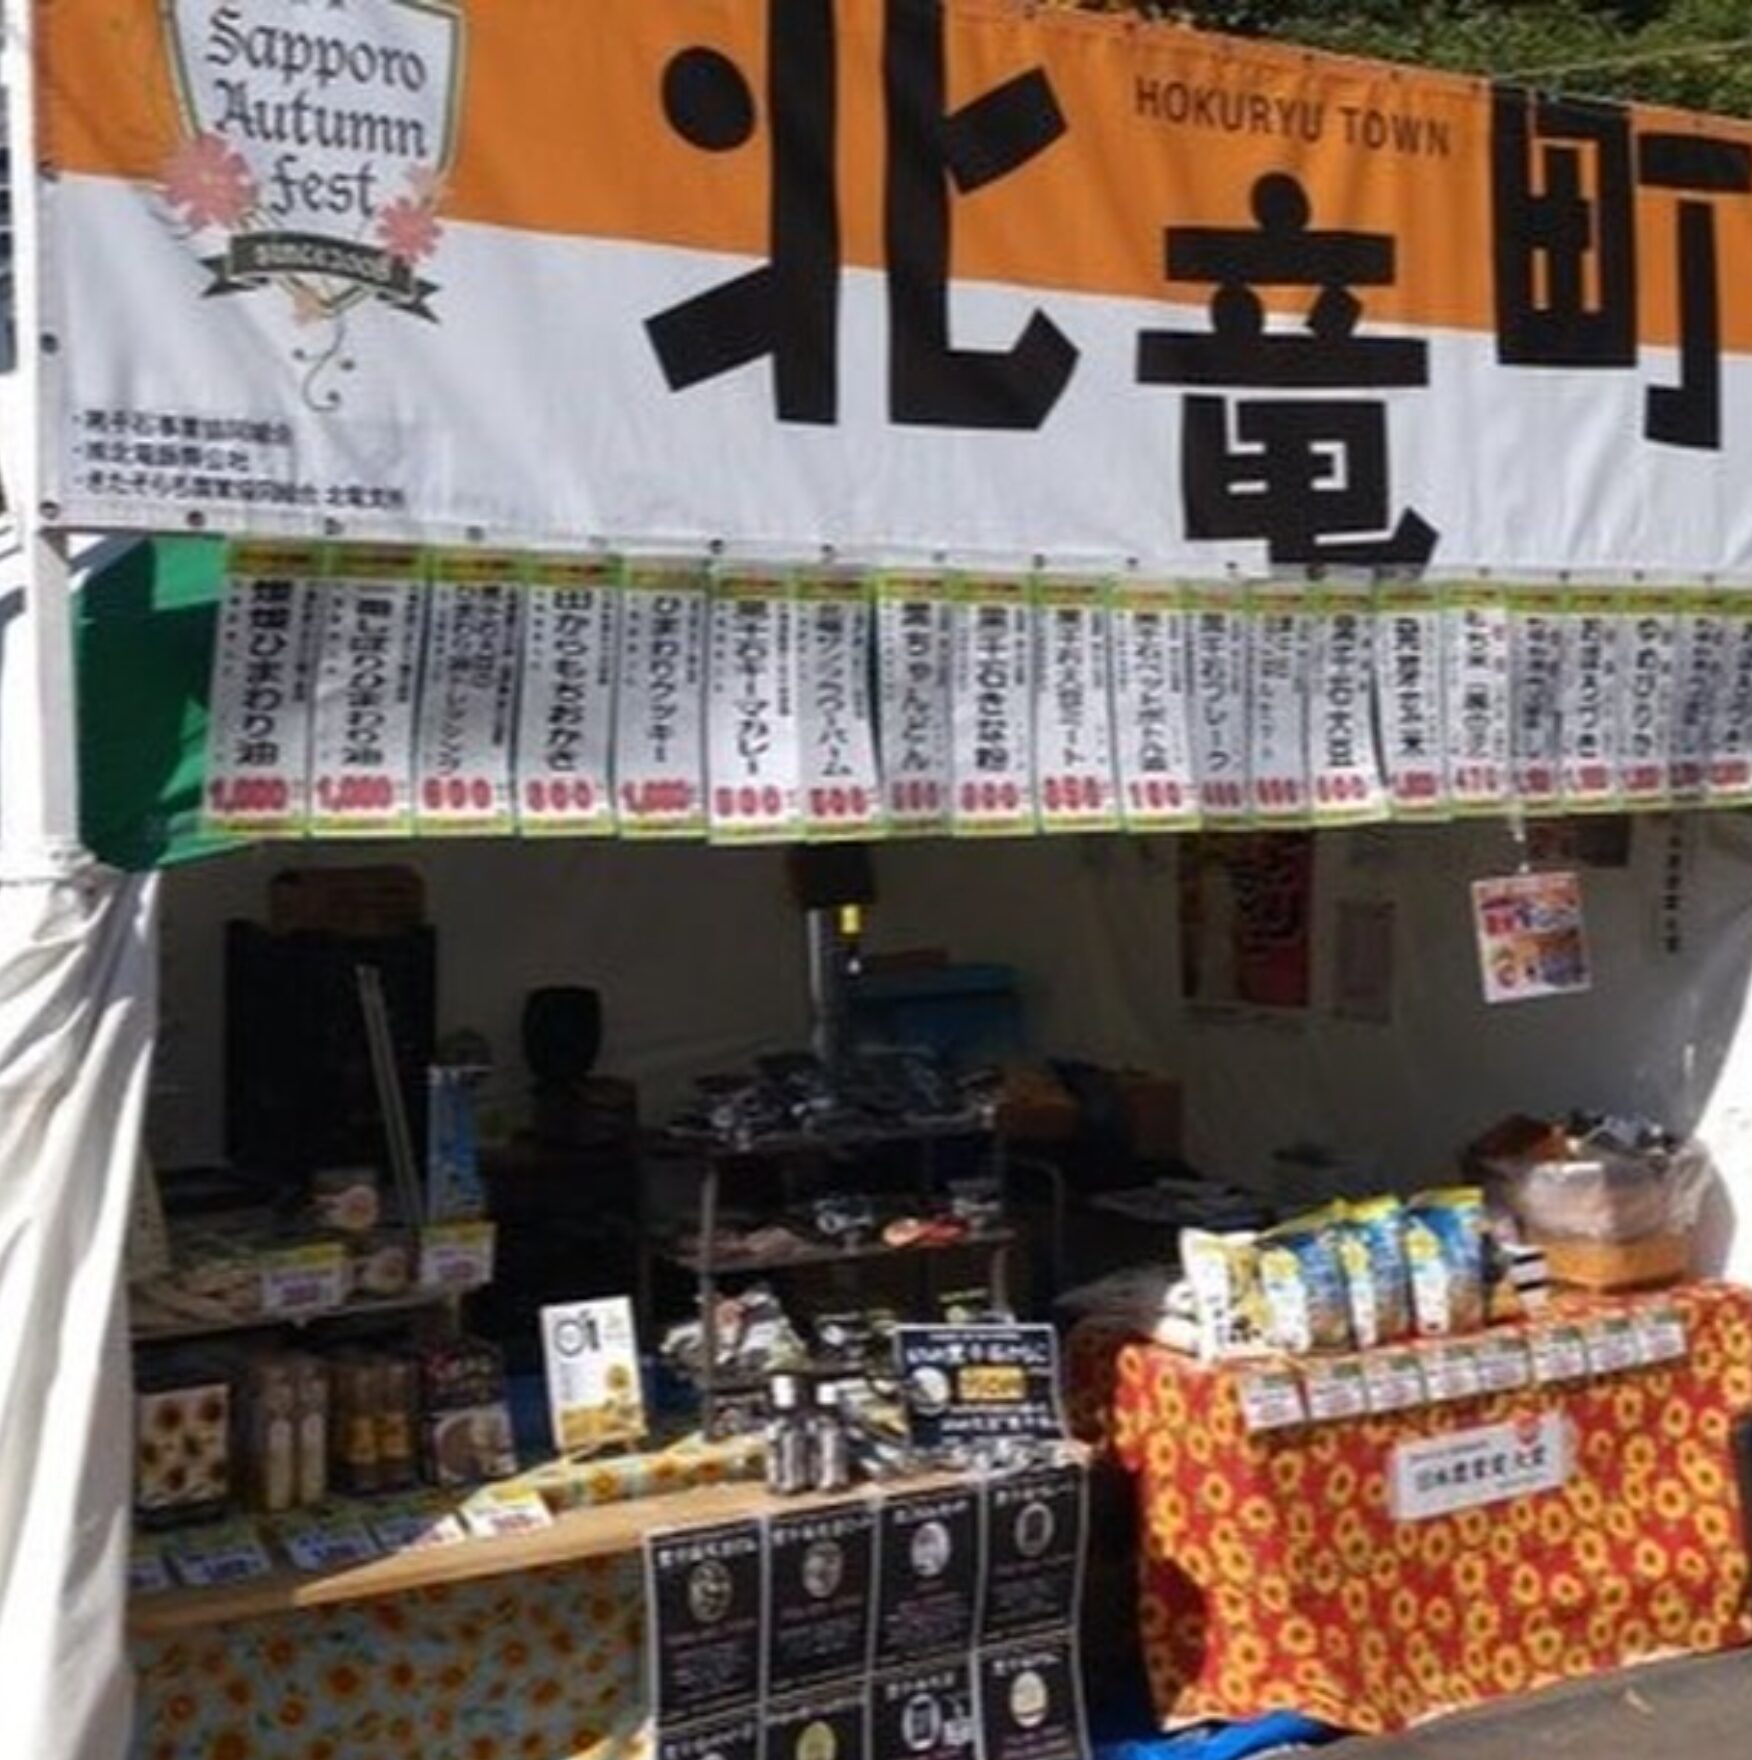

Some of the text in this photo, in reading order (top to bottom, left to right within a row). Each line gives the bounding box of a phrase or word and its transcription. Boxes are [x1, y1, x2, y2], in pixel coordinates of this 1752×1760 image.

[205, 6, 427, 92] Sapporo
[213, 78, 428, 158] Autumn
[1134, 76, 1453, 158] HOKURYU TOWN
